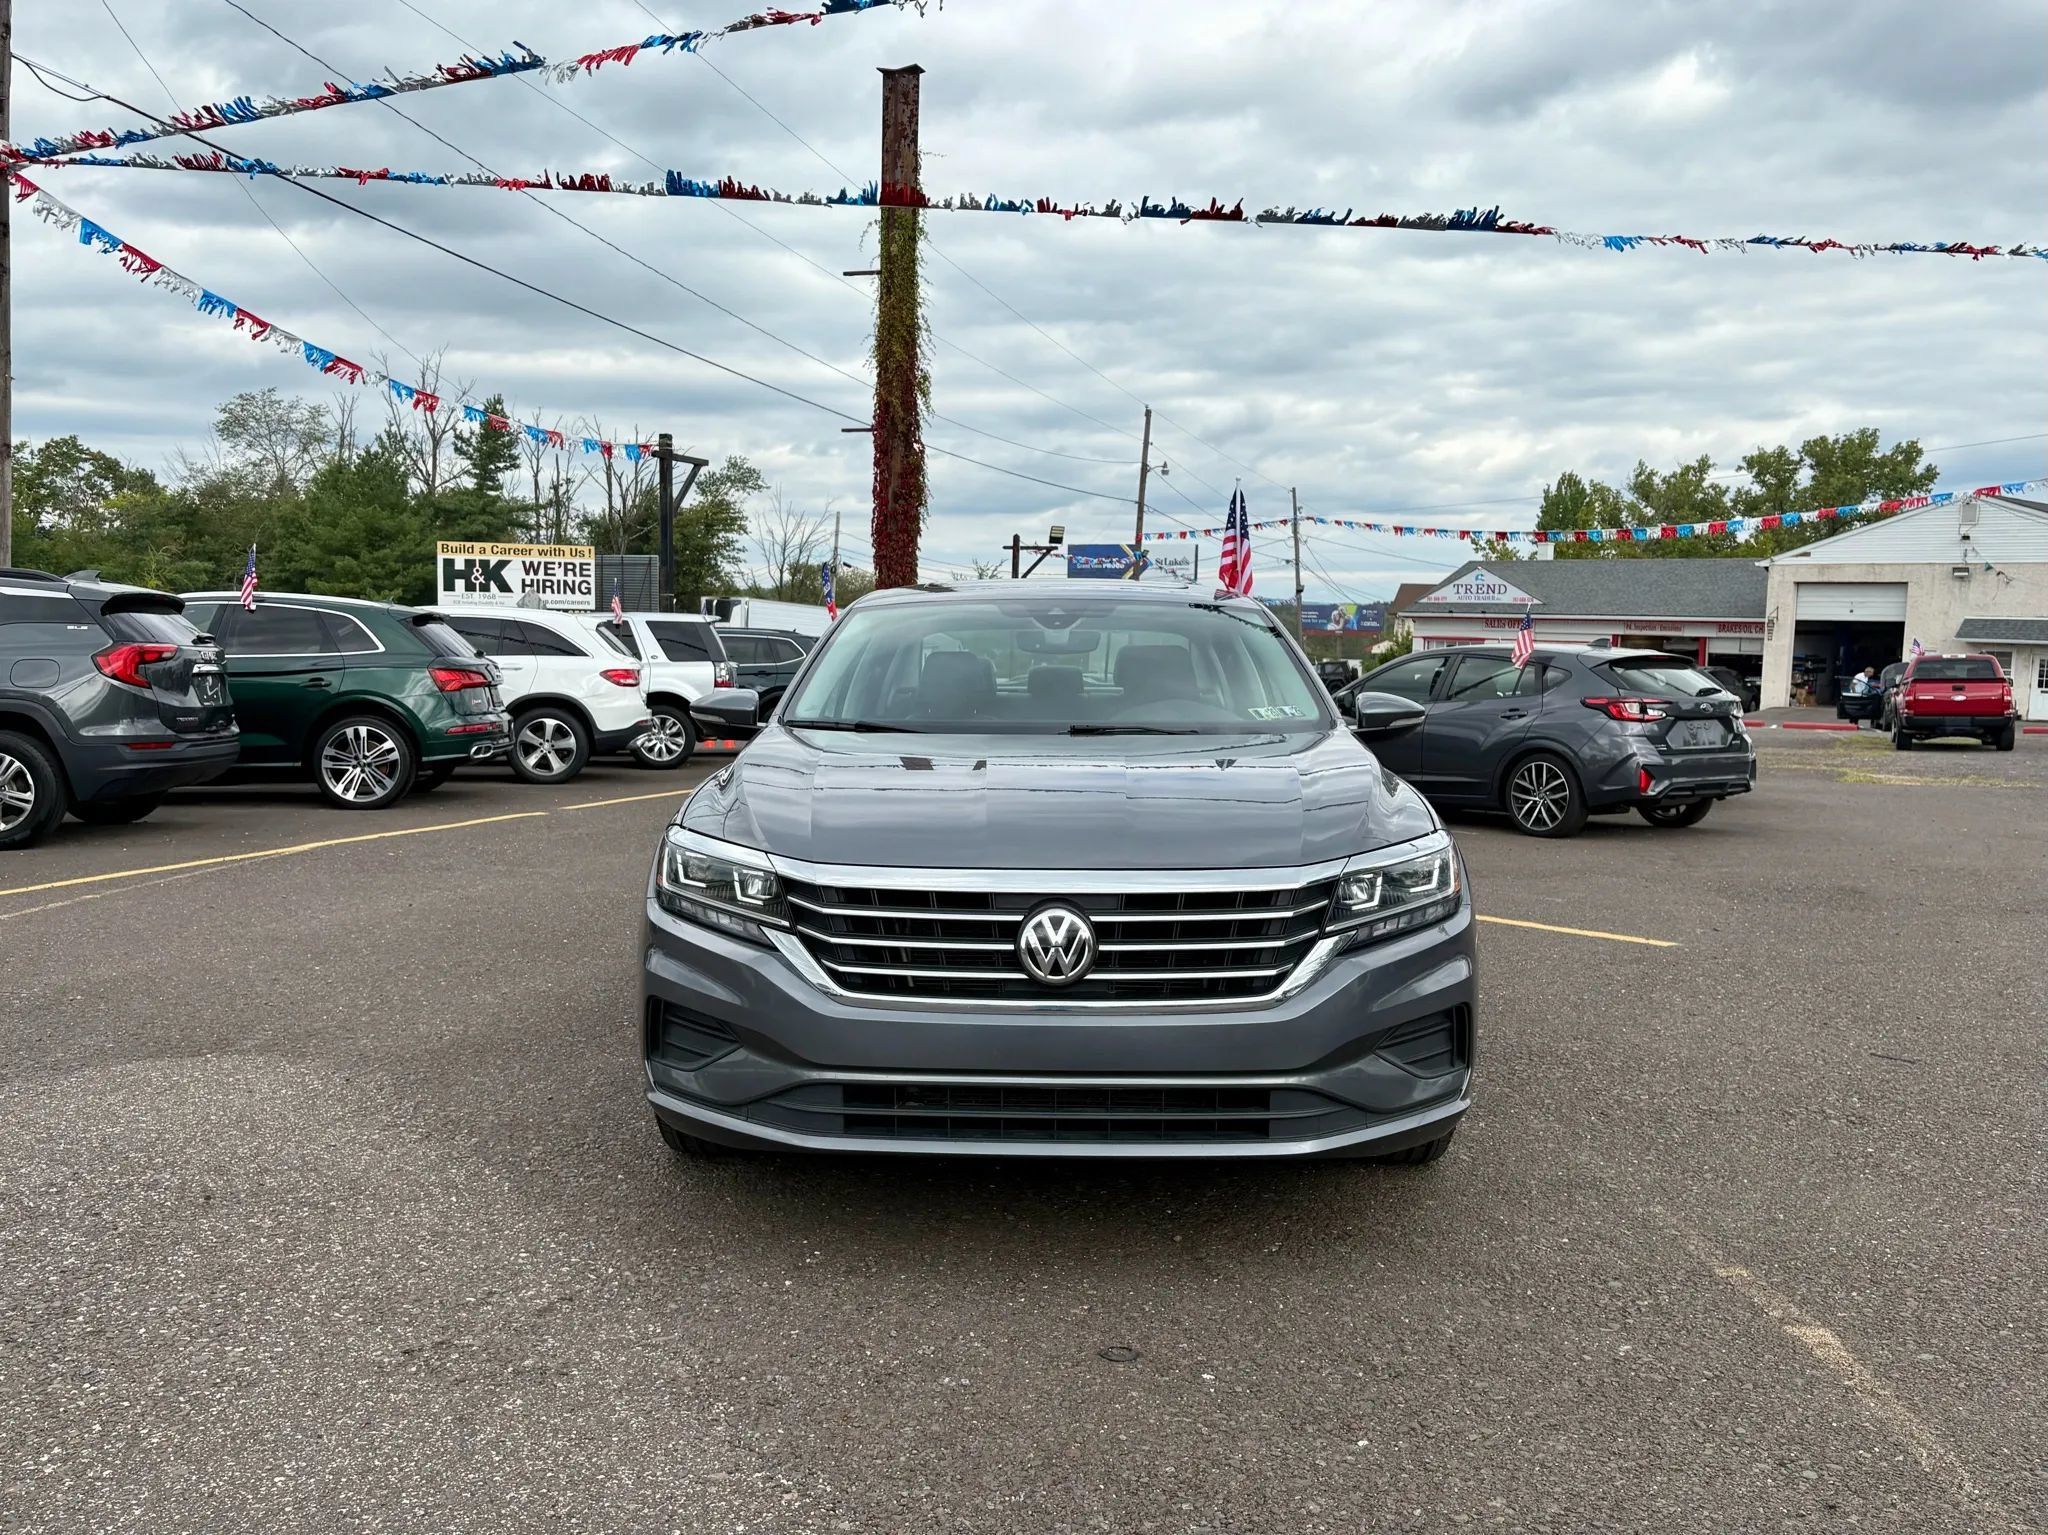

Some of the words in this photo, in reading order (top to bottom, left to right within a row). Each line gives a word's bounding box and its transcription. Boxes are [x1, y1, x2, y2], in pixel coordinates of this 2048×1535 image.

[441, 543, 475, 555] Build
[479, 546, 486, 555] a
[491, 544, 533, 556] Career
[537, 546, 565, 557] with
[521, 560, 592, 578] WE'RE
[521, 578, 592, 595] HIRING
[1453, 583, 1507, 595] TREND
[1484, 618, 1506, 629] SALES
